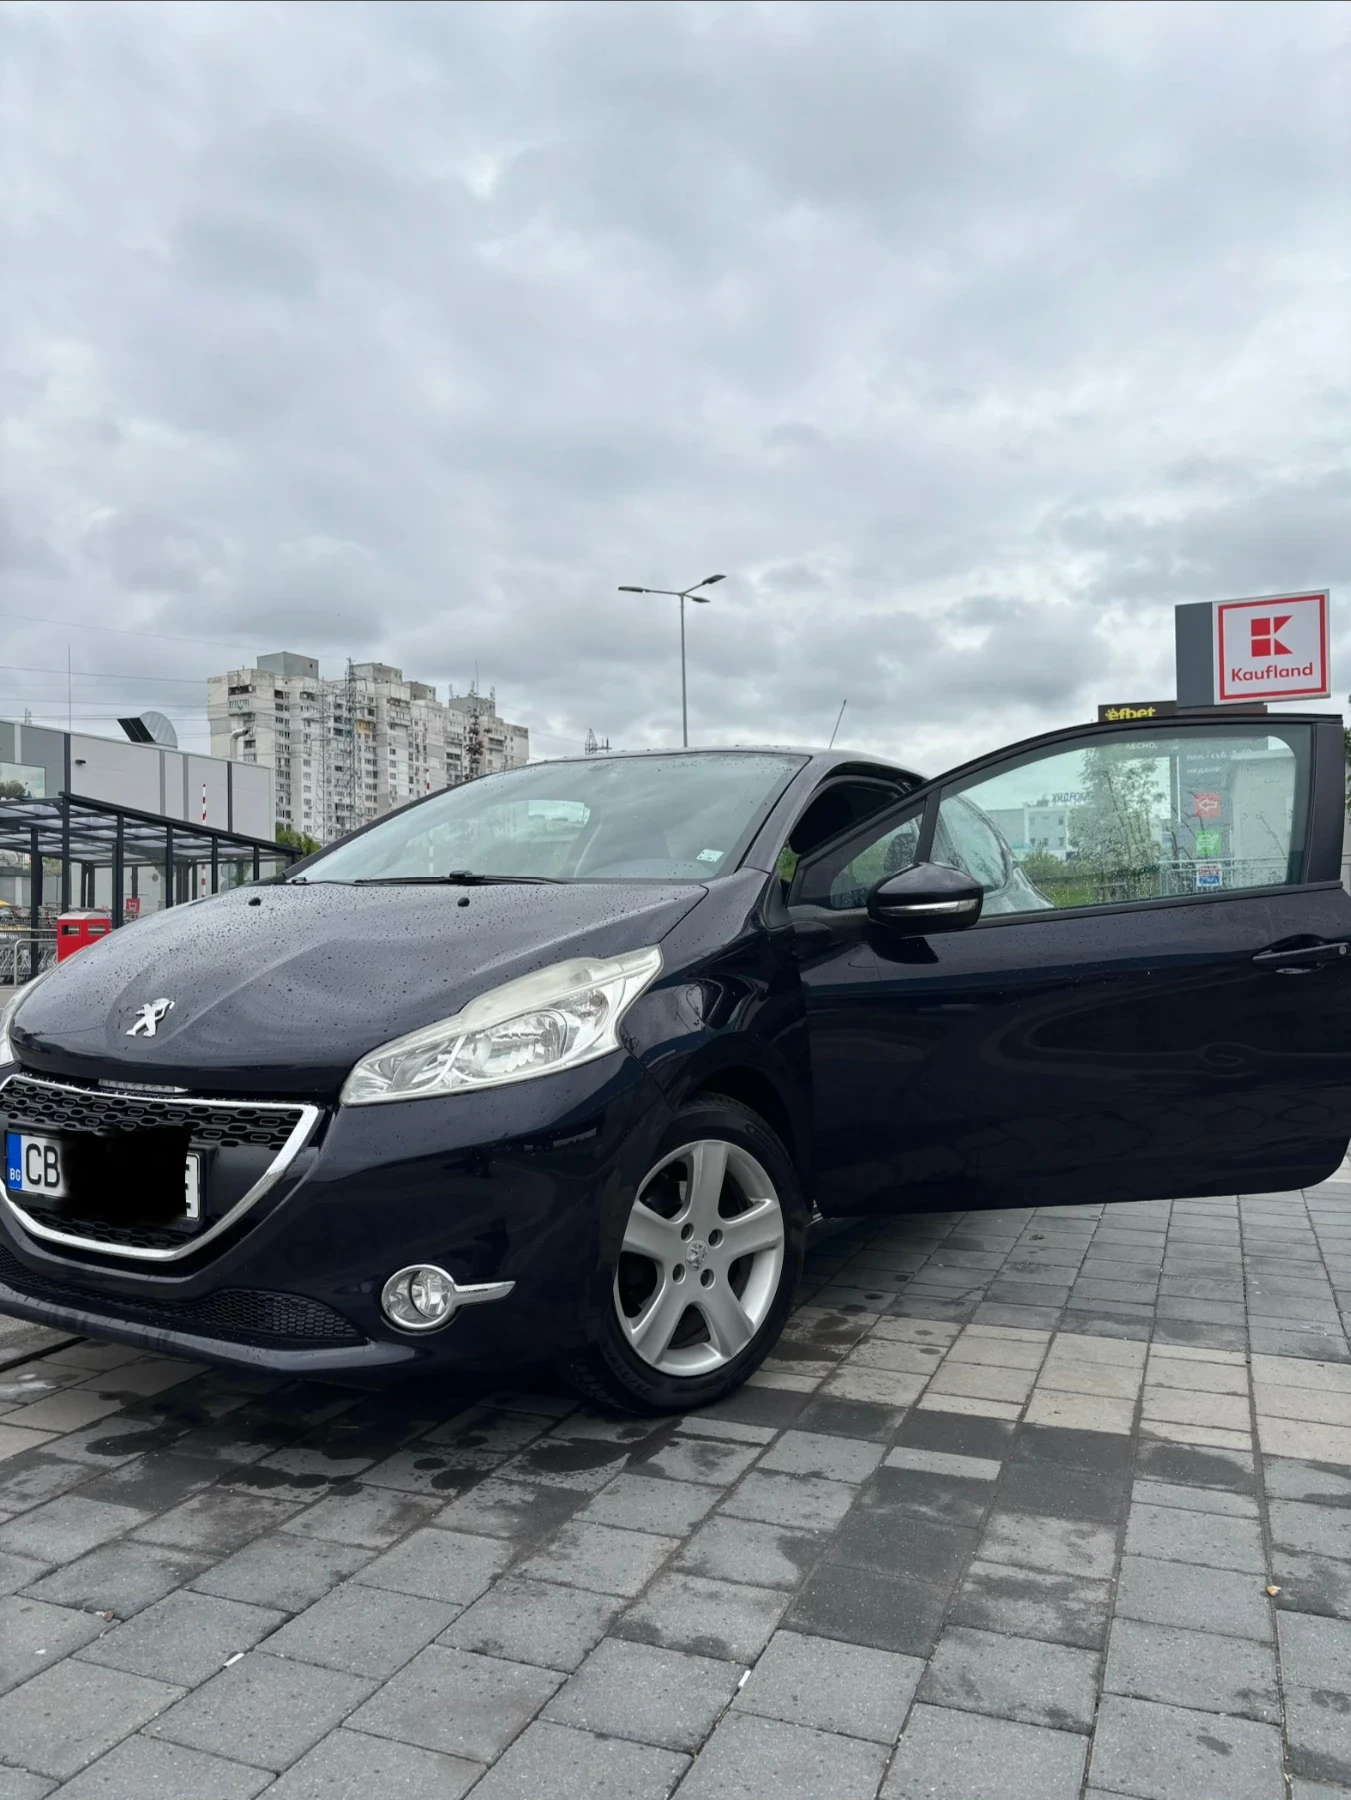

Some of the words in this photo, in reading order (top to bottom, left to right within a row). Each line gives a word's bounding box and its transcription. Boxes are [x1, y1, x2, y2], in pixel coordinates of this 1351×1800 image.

[1231, 662, 1313, 681] Kaufland
[1107, 707, 1156, 721] efbet
[10, 1167, 21, 1181] BG
